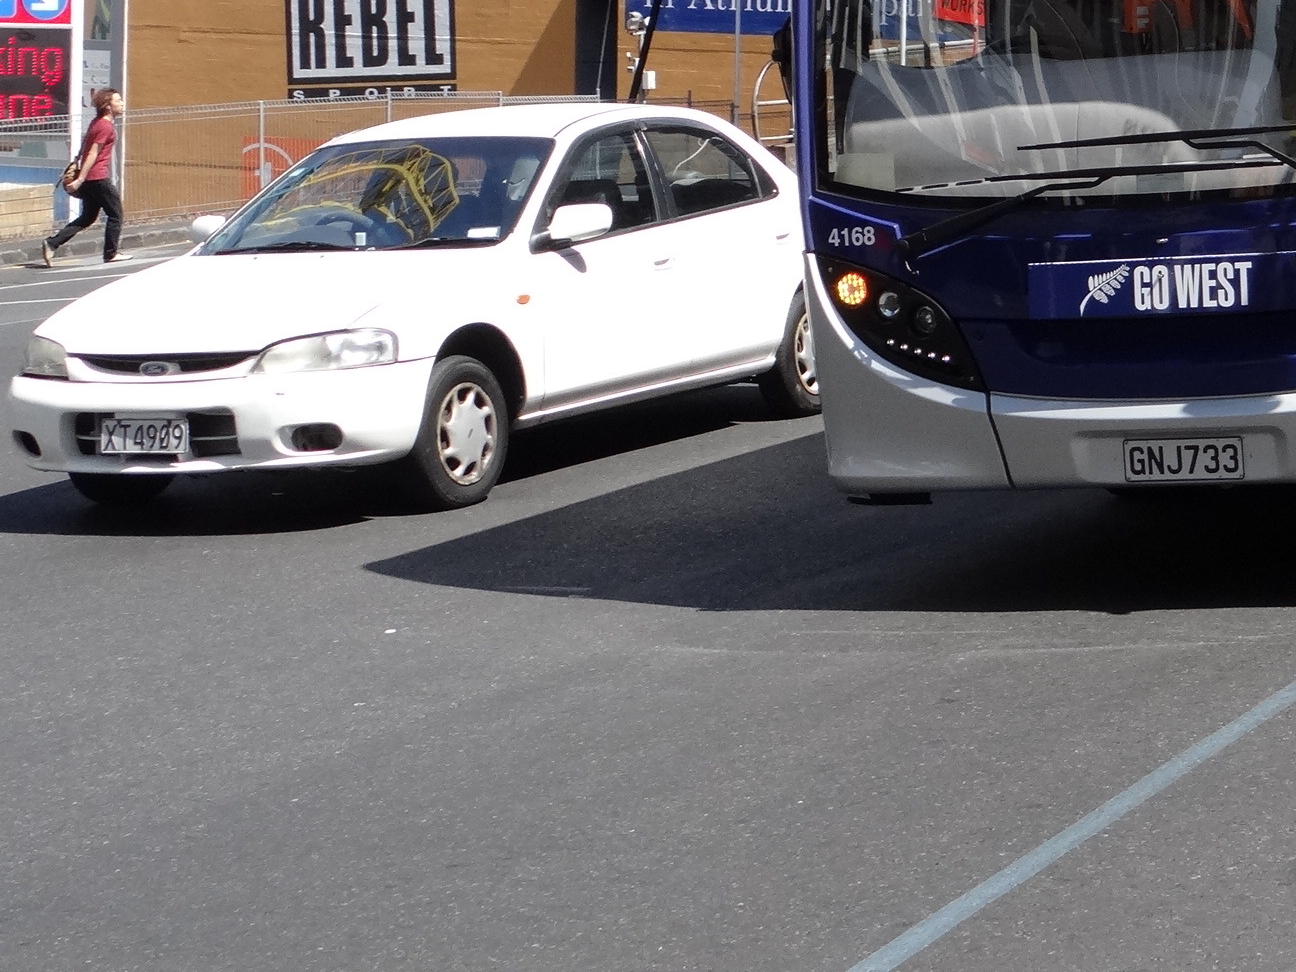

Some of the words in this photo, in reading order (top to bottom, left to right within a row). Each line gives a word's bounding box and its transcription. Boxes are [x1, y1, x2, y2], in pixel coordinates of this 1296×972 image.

[0, 36, 63, 86] ing
[0, 93, 54, 122] ne
[828, 226, 876, 246] 4168
[1133, 264, 1170, 311] GO
[1173, 261, 1253, 309] WEST
[1128, 443, 1240, 476] GNJ733
